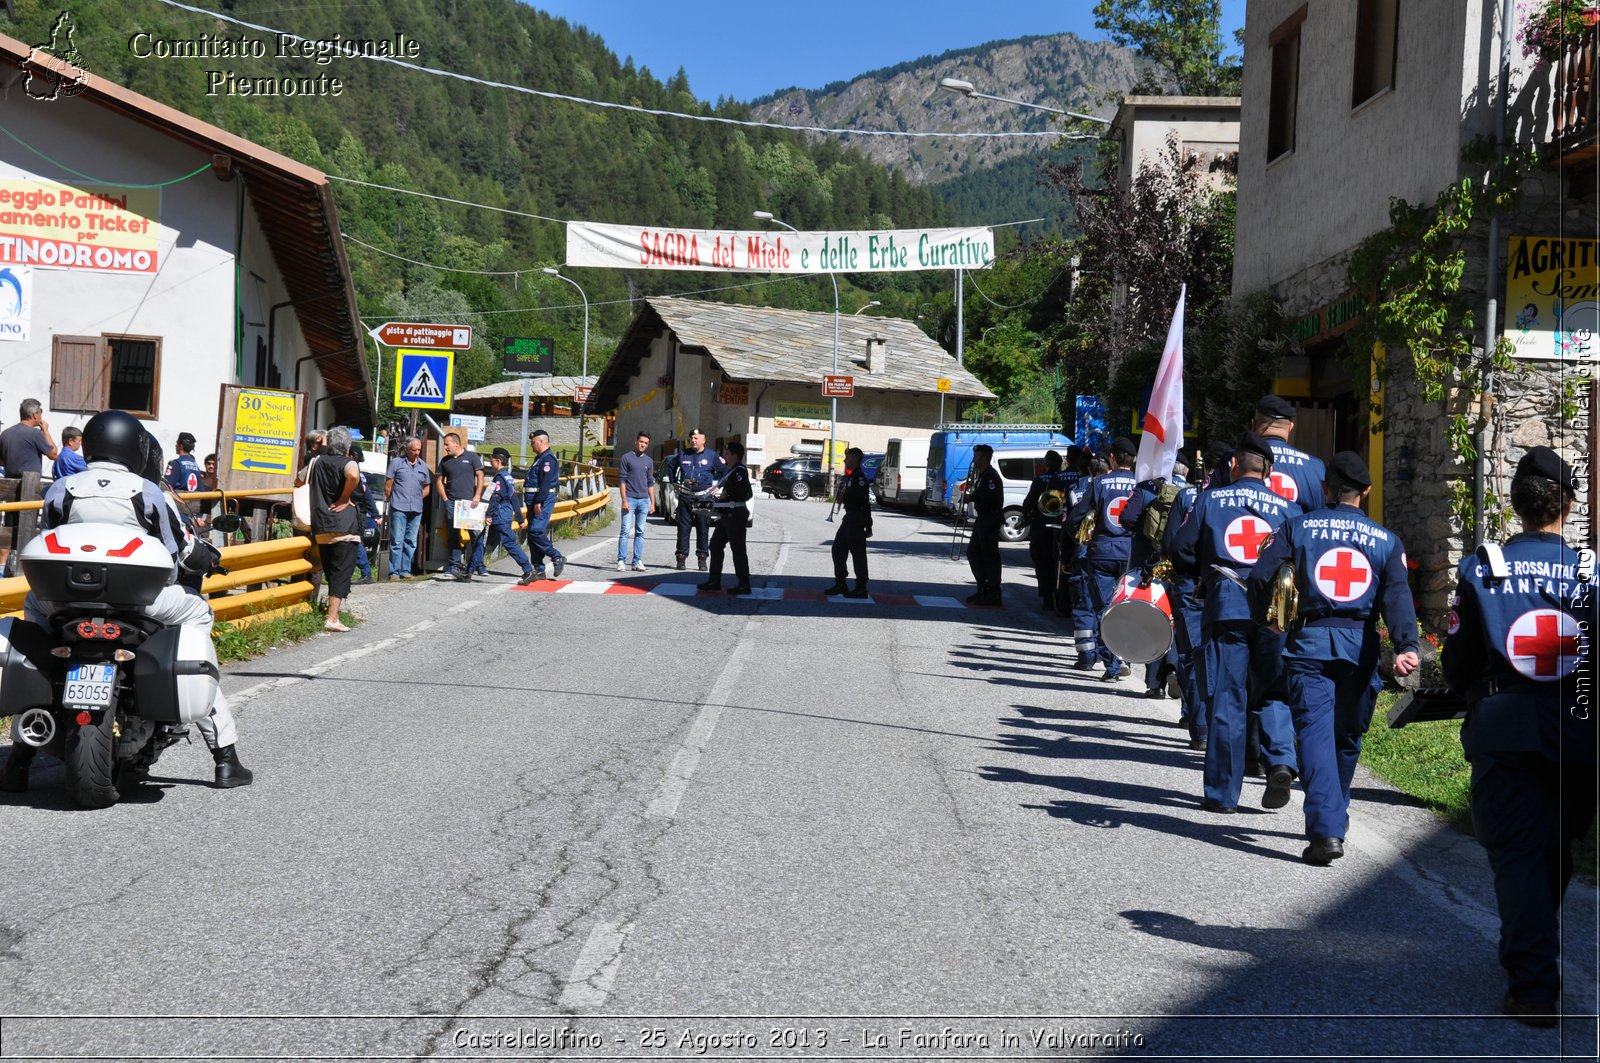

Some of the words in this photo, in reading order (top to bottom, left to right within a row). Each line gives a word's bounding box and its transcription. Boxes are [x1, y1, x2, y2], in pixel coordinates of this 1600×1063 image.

[60, 191, 127, 211] Pattini
[0, 211, 81, 229] amento
[85, 213, 149, 234] Ticket
[77, 231, 98, 242] per
[0, 236, 152, 270] TINODROMO
[640, 231, 700, 266] SAGRA
[712, 235, 736, 268] del
[747, 235, 790, 269] Miele
[801, 248, 809, 269] e
[820, 236, 858, 270] delle
[868, 235, 907, 269] Erbe
[918, 233, 989, 266] Curative
[386, 326, 404, 335] pista
[406, 327, 413, 335] di
[413, 328, 452, 338] pattinaggio
[410, 337, 435, 345] rotelle
[265, 401, 292, 412] Sagra
[237, 424, 256, 434] erbe
[255, 437, 279, 445] AGOSTO
[1274, 454, 1303, 466] FARA
[1211, 488, 1234, 499] CROCE
[1236, 488, 1257, 500] ROSSA
[1258, 491, 1288, 509] ITALIANA
[1220, 498, 1279, 516] FANFARA
[1303, 519, 1329, 529] CROCE
[1330, 518, 1355, 530] ROSSA
[1356, 521, 1388, 541] ITALIANA
[1312, 529, 1376, 549] FANFARA
[1515, 560, 1550, 577] ROSSA
[80, 665, 97, 680] DV
[68, 684, 110, 701] 63055
